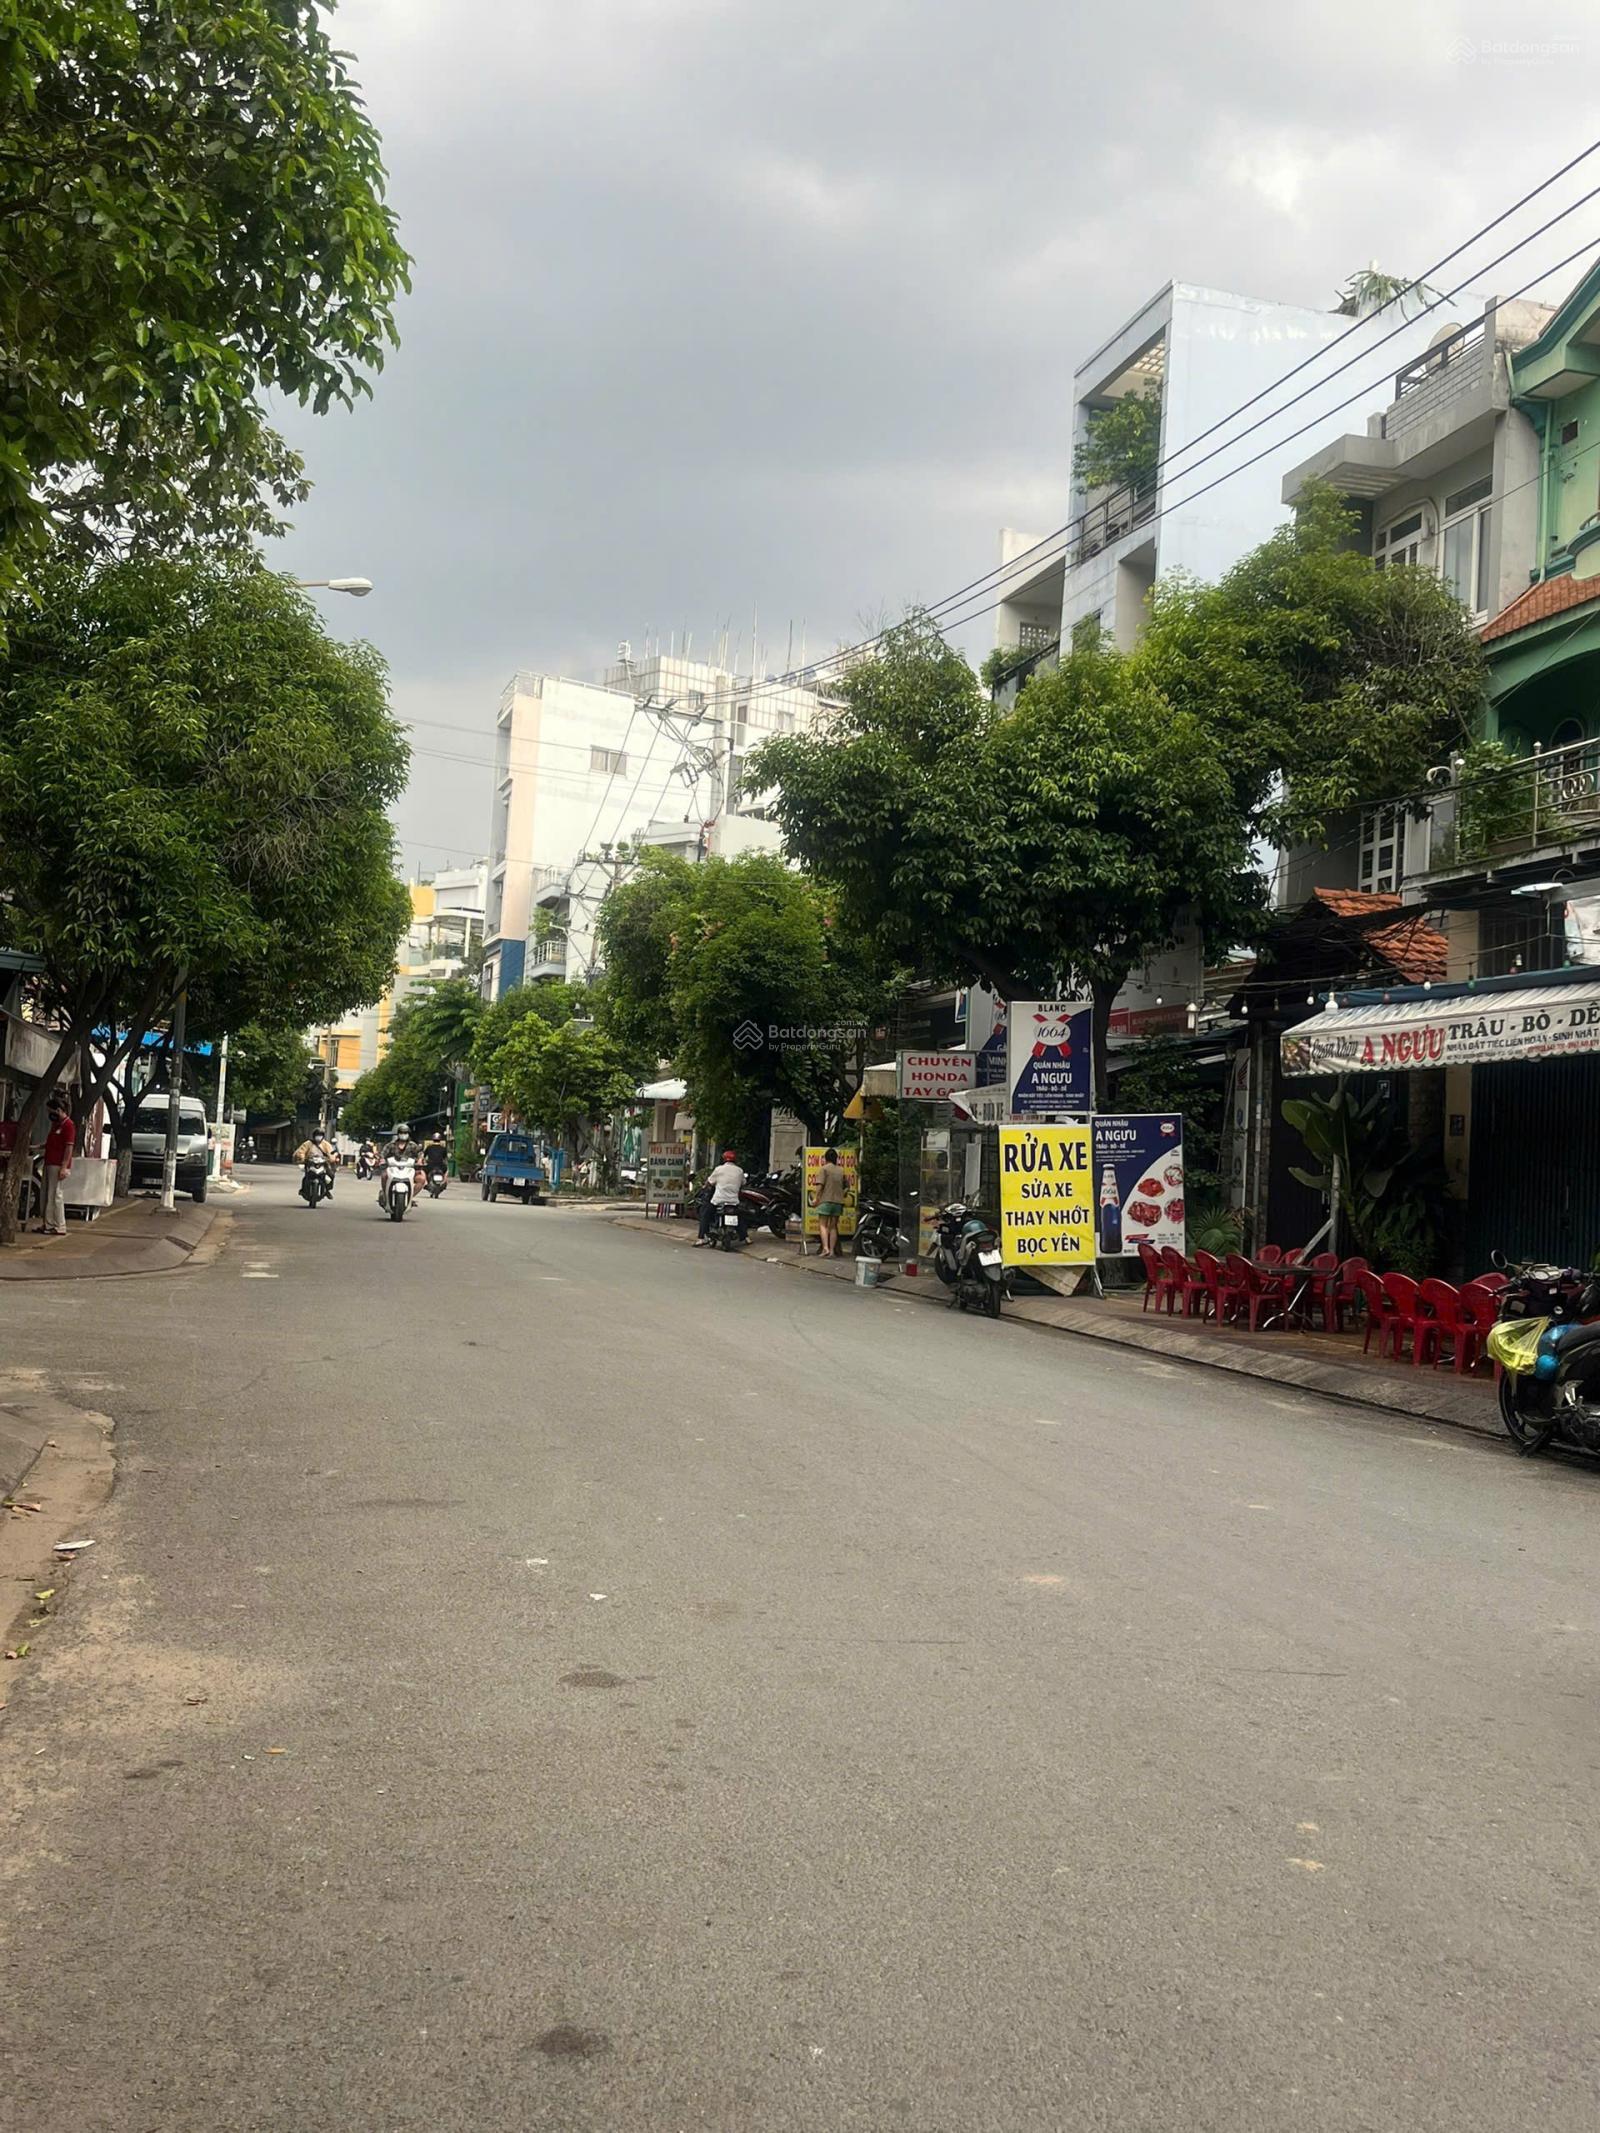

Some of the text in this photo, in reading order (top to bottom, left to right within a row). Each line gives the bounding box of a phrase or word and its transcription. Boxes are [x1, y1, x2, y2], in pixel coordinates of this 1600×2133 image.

[1038, 1004, 1066, 1012] BLANC
[1448, 1016, 1504, 1040] TRÂU
[1521, 1009, 1551, 1033] BÒ
[1569, 1001, 1600, 1026] DÊ
[1037, 1026, 1067, 1038] 1664
[1552, 1030, 1574, 1042] SINH
[1360, 1036, 1376, 1065] A
[1380, 1024, 1447, 1065] NGƯU
[907, 1056, 972, 1067] CHUYÊN
[1033, 1060, 1052, 1070] QUÁN
[912, 1072, 968, 1082] HONDA
[1031, 1072, 1072, 1084] A NGƯU
[903, 1087, 933, 1097] TAY
[1095, 1119, 1111, 1128] QUÁN
[1096, 1129, 1136, 1141] A NGƯU
[1004, 1132, 1088, 1172] RỬA XE
[1021, 1178, 1073, 1198] SỬA XE
[1005, 1205, 1089, 1226] THAY NHỚT
[1017, 1233, 1080, 1257] BỌC YÊN
